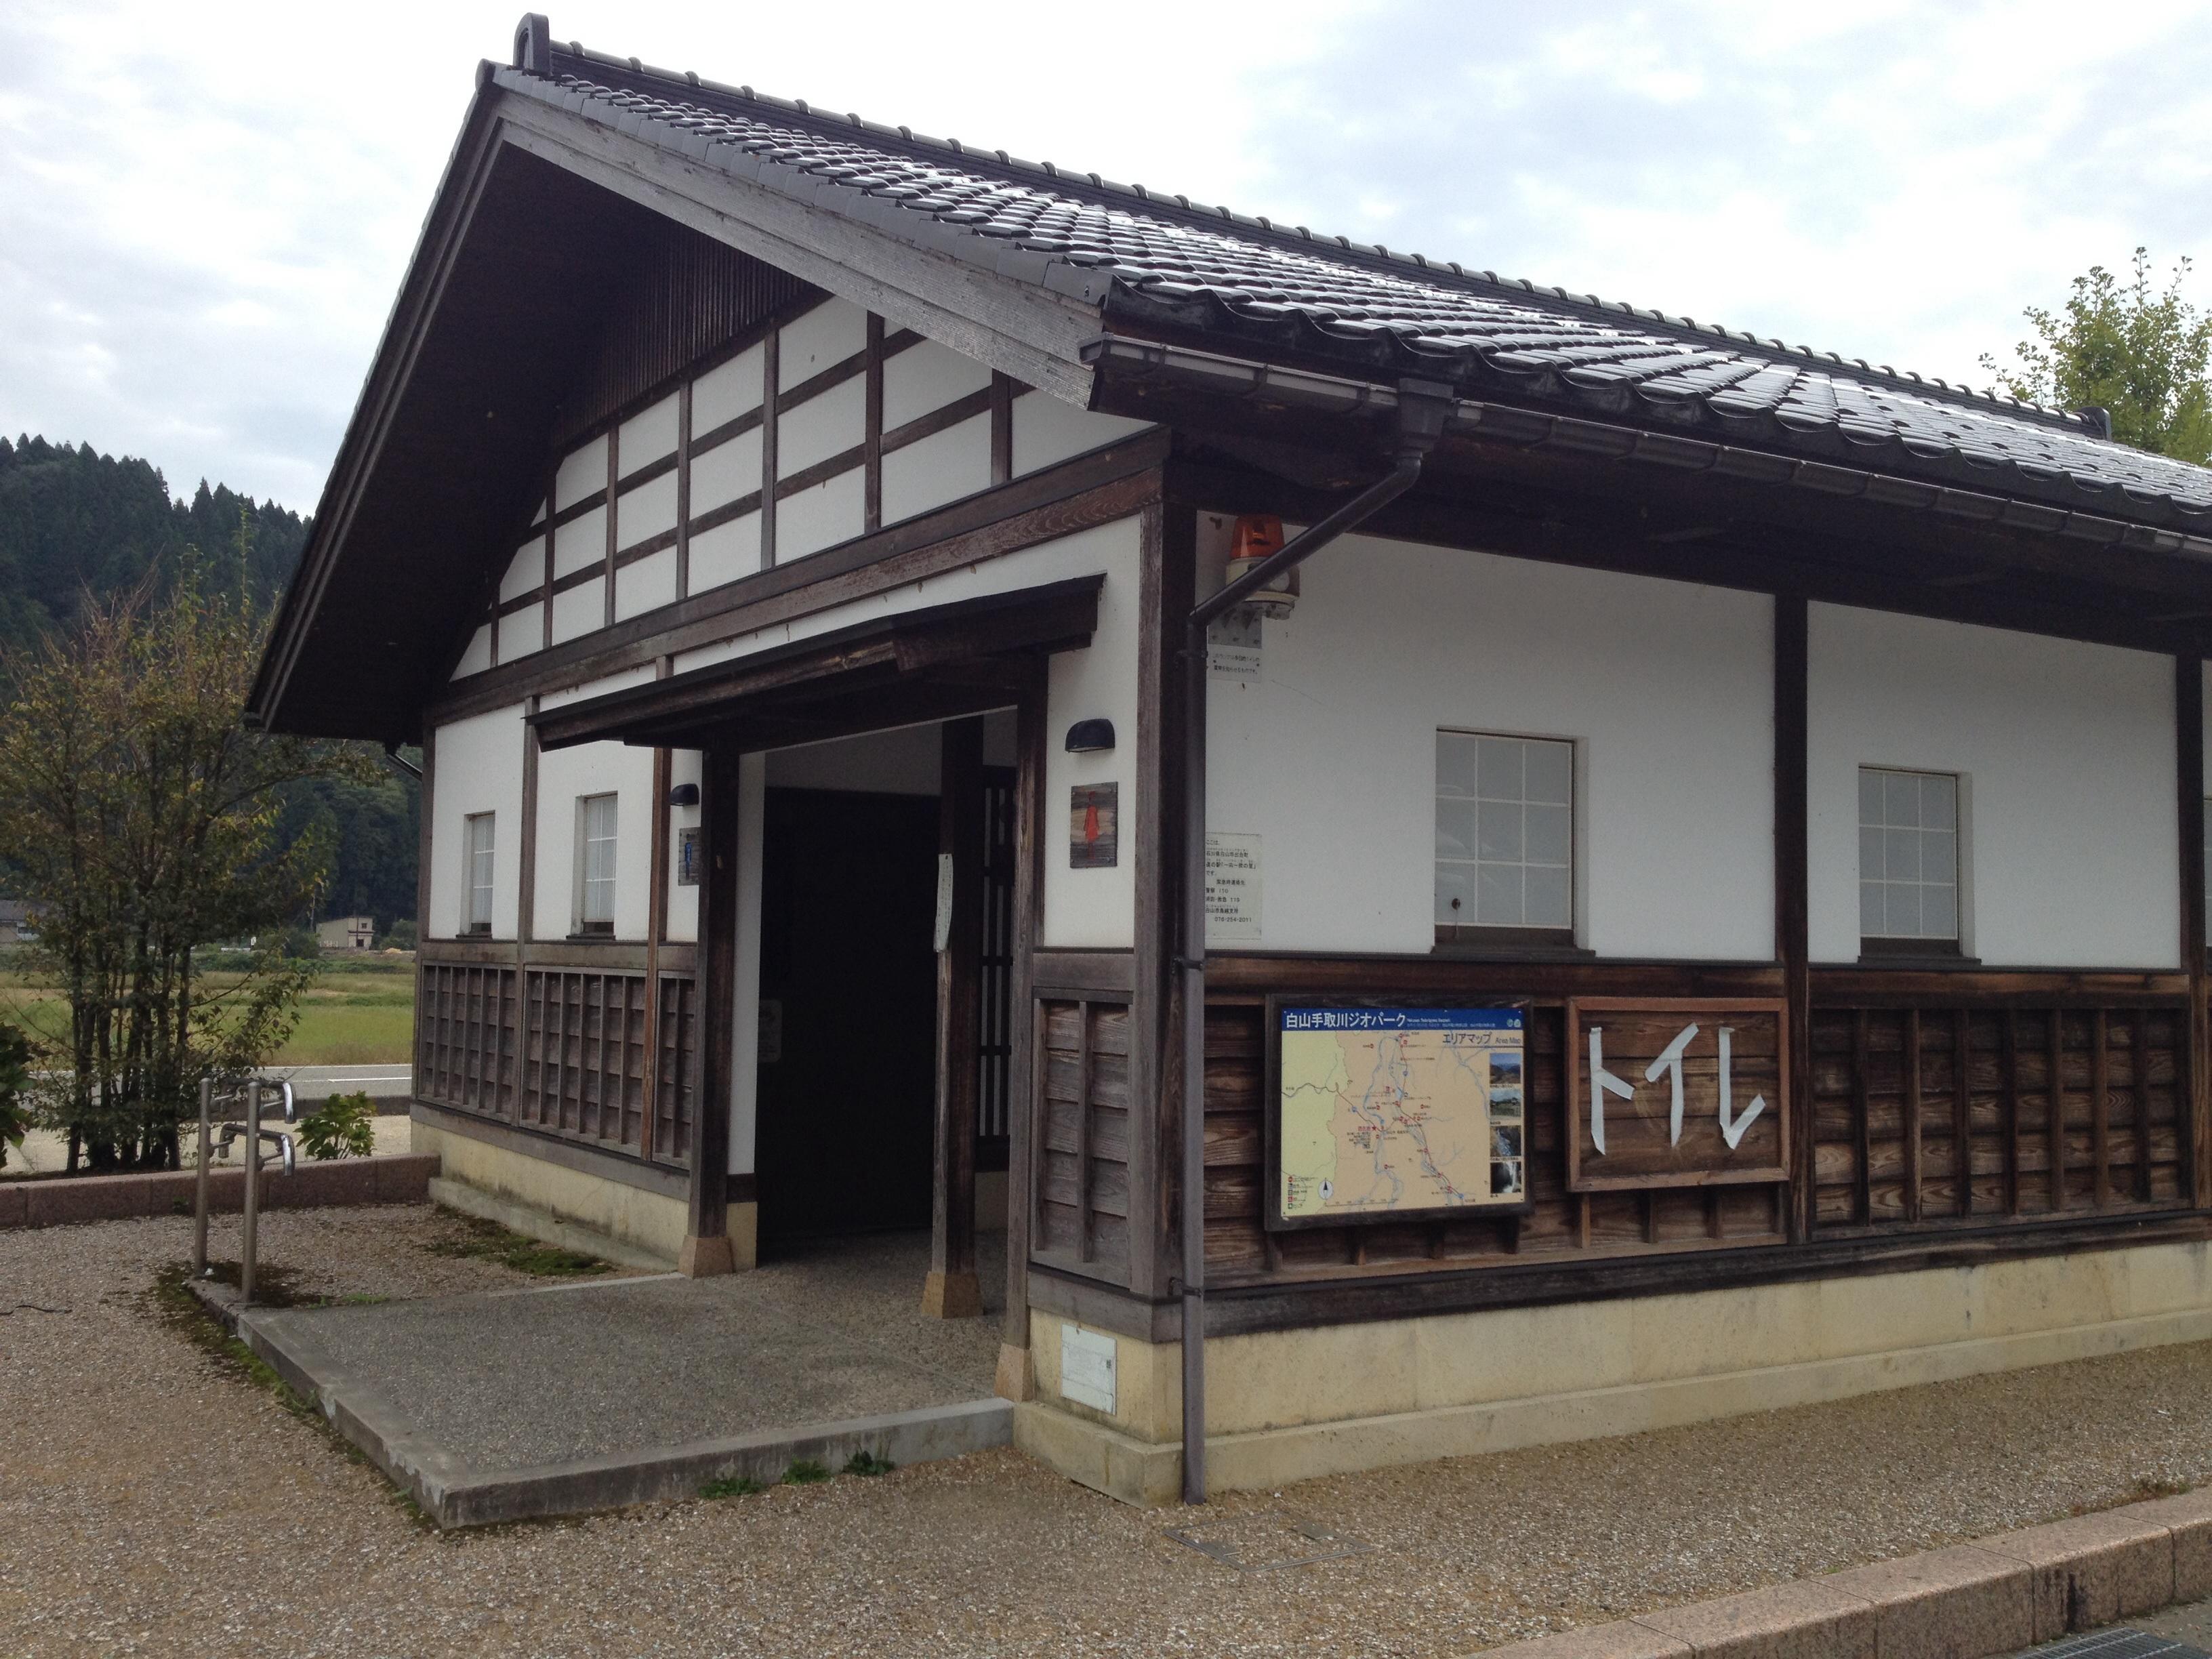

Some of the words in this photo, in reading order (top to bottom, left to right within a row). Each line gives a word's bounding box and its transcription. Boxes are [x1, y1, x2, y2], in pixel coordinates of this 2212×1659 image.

[1286, 1011, 1406, 1028] 白山手取川ジオパーク
[1442, 1031, 1492, 1045] エリアマップ
[1589, 1021, 1766, 1155] トイレ
